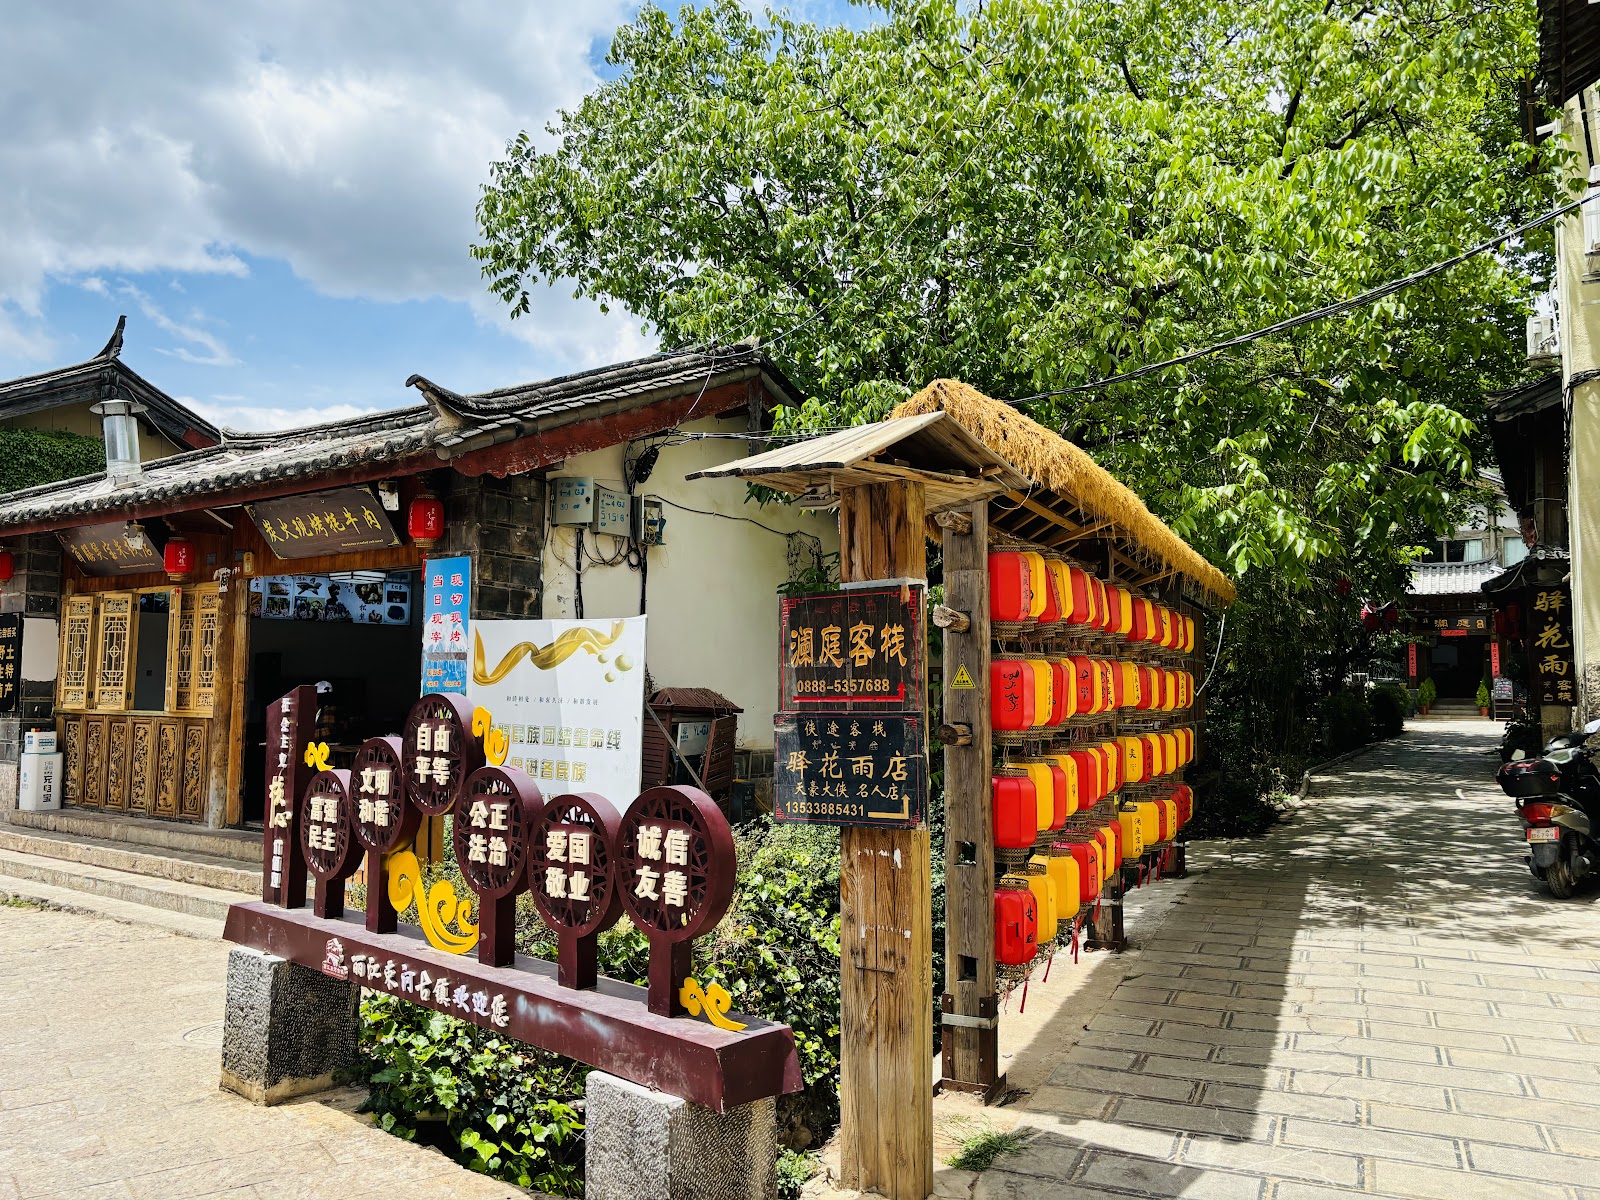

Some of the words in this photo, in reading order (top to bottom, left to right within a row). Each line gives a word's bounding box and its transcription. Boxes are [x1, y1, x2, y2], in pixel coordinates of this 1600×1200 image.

[262, 506, 382, 543] 炭火现烤牦牛肉
[431, 575, 444, 643] 当日现宰
[449, 573, 463, 643] 现切现烤
[790, 620, 908, 668] 澜庭客栈
[797, 679, 890, 693] 0888-5357688
[1557, 680, 1573, 702] 客栈
[417, 723, 450, 752] 自由
[805, 720, 887, 738] 侠途客栈
[359, 767, 391, 795] 文明
[414, 756, 450, 786] 平等
[786, 750, 909, 782] 驿花雨店
[794, 780, 850, 798] 天豪大侠
[856, 783, 900, 800] 名人店
[310, 796, 339, 823] 富强
[359, 799, 390, 827] 和谐
[469, 800, 509, 831] 公正
[786, 801, 864, 817] 13533885431
[308, 825, 336, 852] 民主
[468, 833, 508, 867] 法治
[546, 830, 591, 865] 爱国
[636, 825, 690, 866] 诚信
[545, 867, 590, 902] 敬业
[634, 865, 688, 907] 友善
[350, 954, 510, 1028] 丽江束河古镇欢迎您
